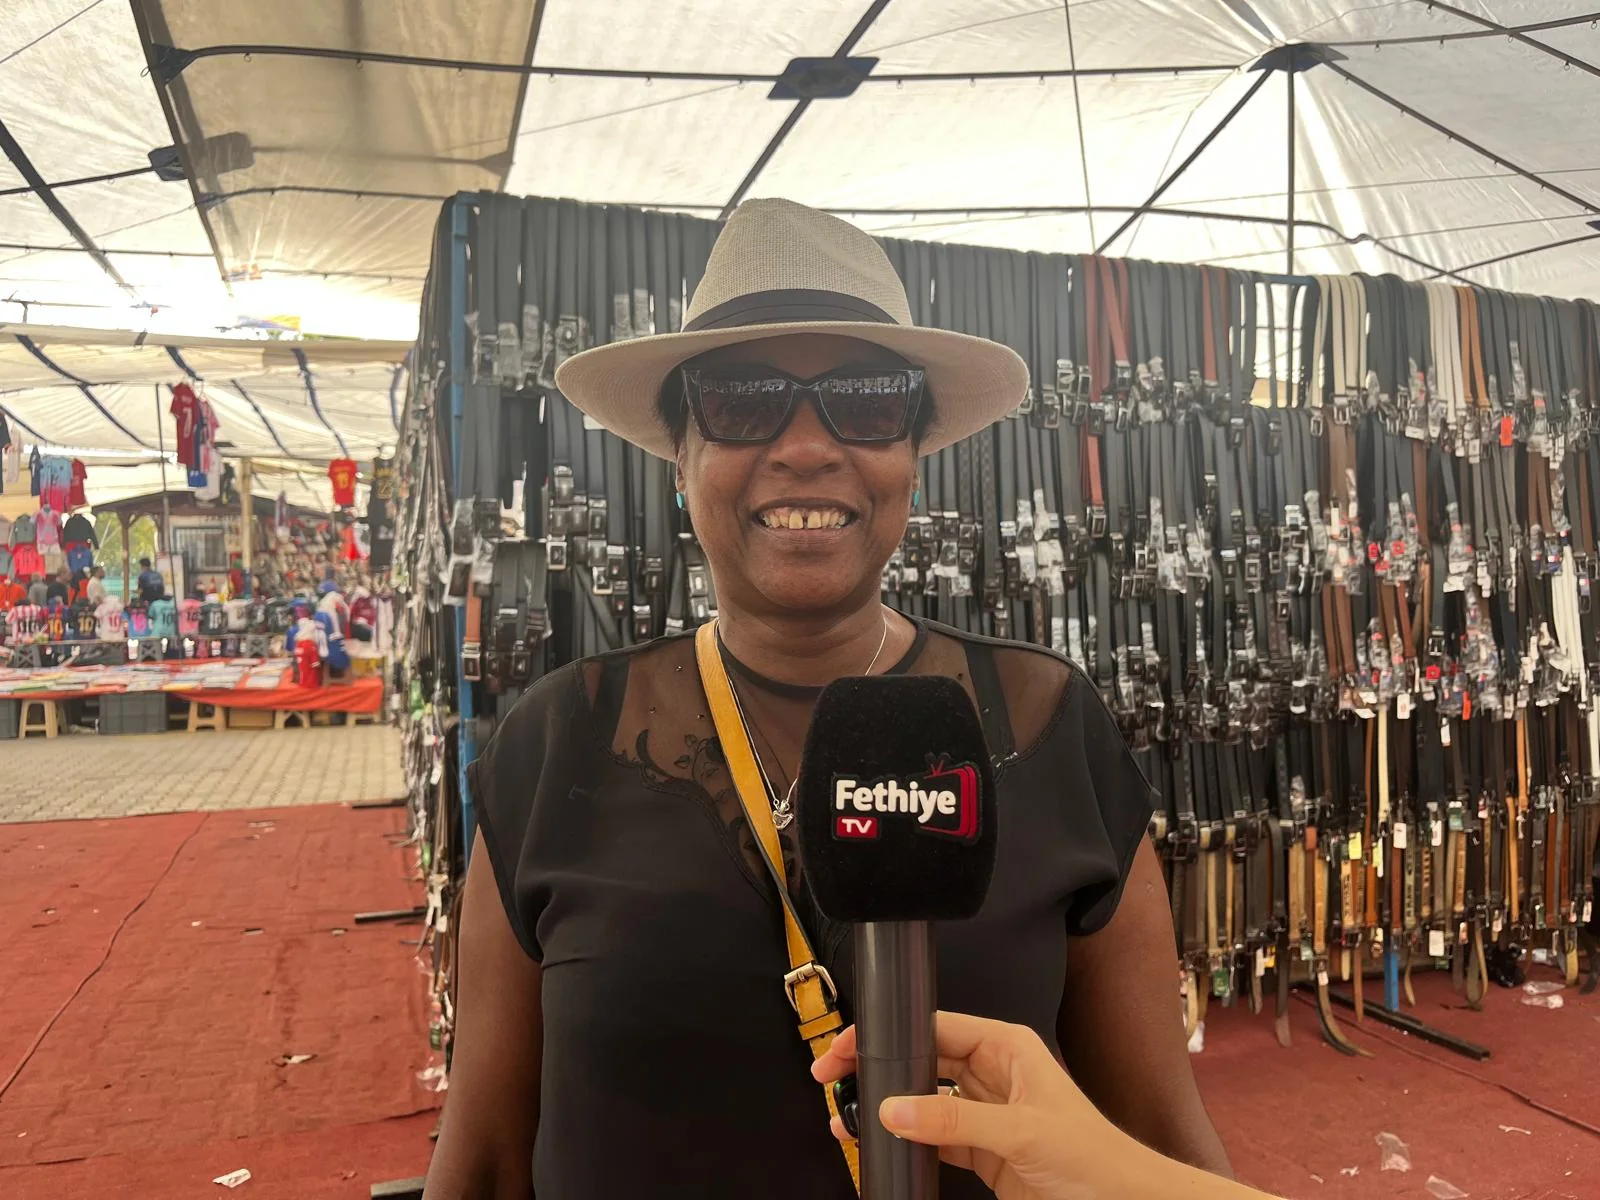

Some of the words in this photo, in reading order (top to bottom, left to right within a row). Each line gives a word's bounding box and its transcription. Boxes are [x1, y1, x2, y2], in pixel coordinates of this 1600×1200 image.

[183, 407, 192, 438] 7
[48, 618, 63, 635] 10
[79, 616, 94, 633] 10
[836, 780, 957, 824] Fethiye
[842, 818, 872, 833] TV
